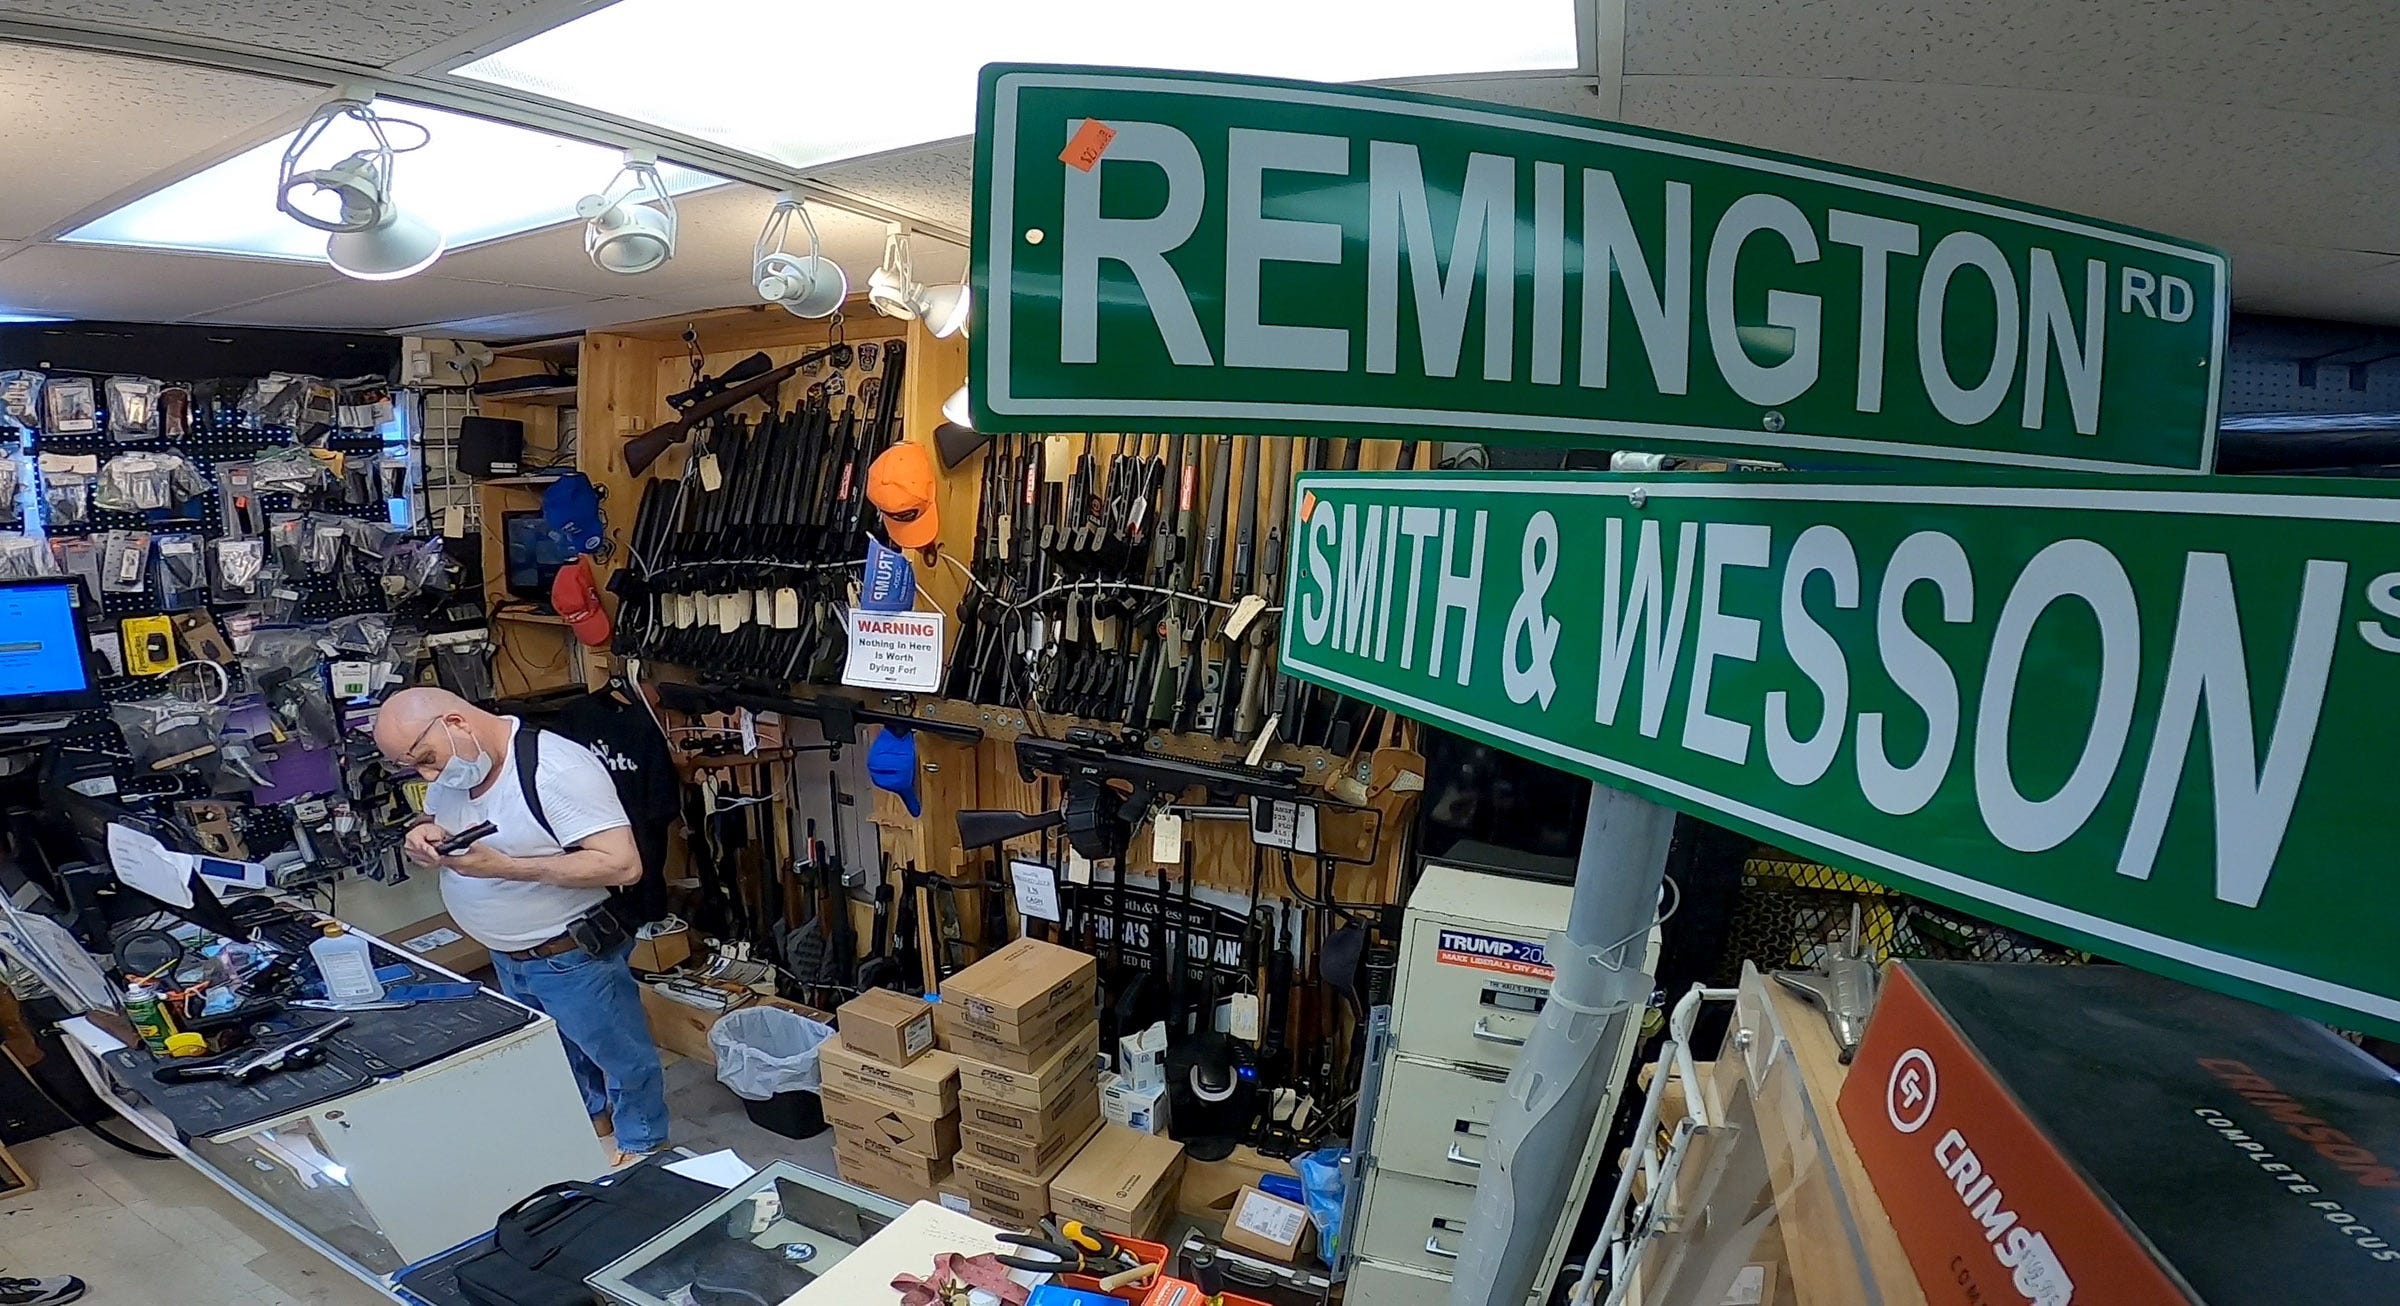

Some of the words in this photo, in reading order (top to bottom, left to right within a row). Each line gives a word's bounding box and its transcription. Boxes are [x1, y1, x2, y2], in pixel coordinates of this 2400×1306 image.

[1060, 118, 2107, 436] REMINGTON
[2121, 266, 2195, 324] RD
[858, 619, 934, 637] WARNING
[858, 638, 895, 650] Nothing
[897, 641, 907, 649] In
[909, 642, 932, 651] Here
[875, 651, 883, 660] Is
[886, 652, 914, 662] Worth
[869, 662, 896, 674] Dying
[1302, 498, 1488, 688] SMITH
[1501, 510, 1562, 713] &
[1595, 517, 2348, 909] WESSON
[1442, 952, 1468, 963] MAKE
[1470, 955, 1511, 969] LIBERALS
[1512, 964, 1531, 973] CRY
[2194, 1108, 2321, 1194] COMPLETE
[2309, 1201, 2400, 1261] FOCUS
